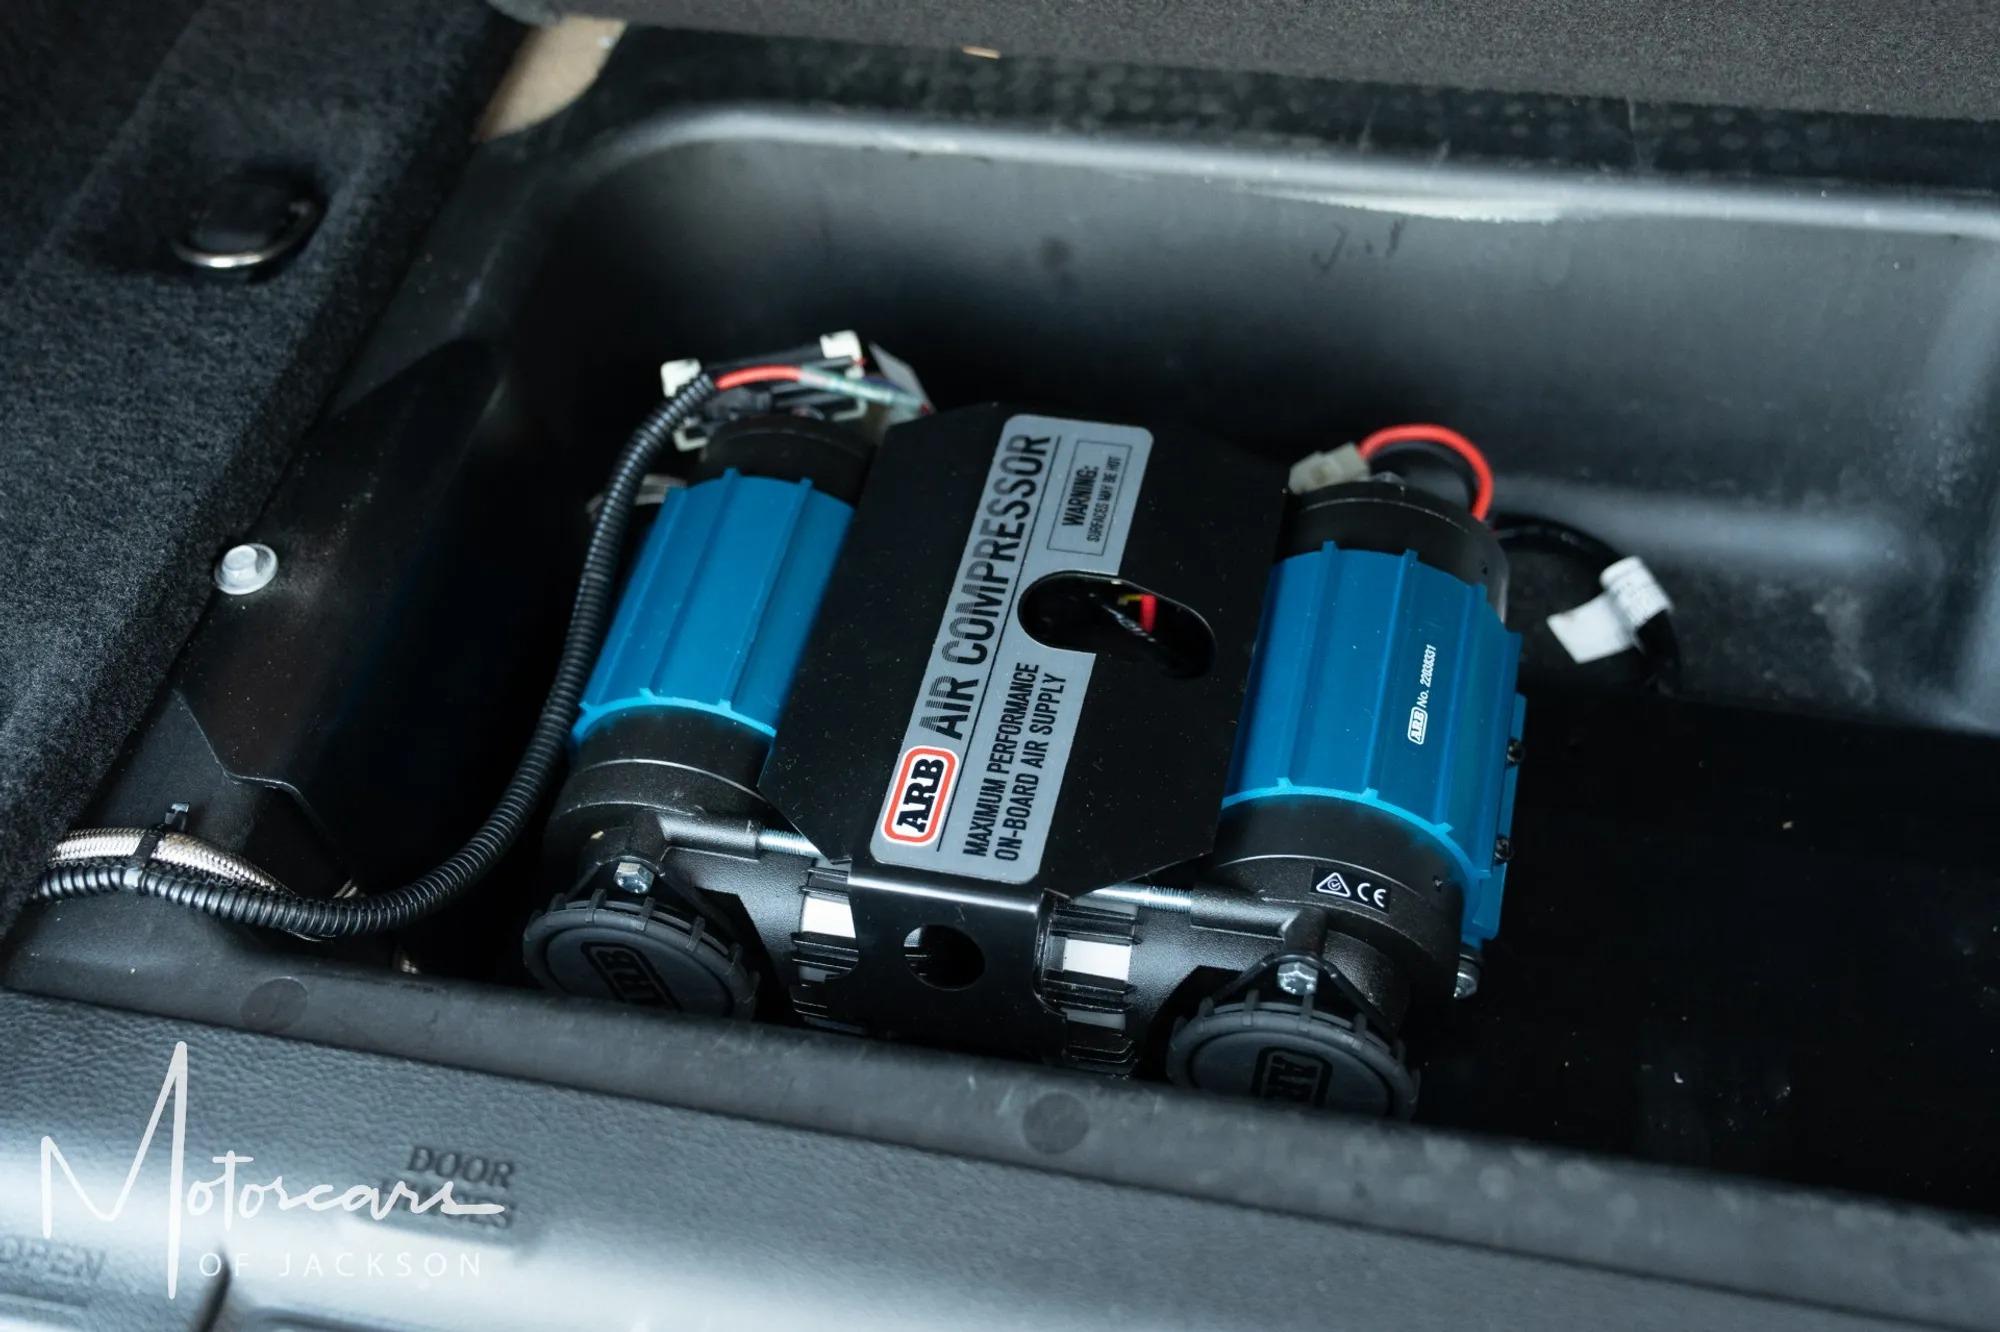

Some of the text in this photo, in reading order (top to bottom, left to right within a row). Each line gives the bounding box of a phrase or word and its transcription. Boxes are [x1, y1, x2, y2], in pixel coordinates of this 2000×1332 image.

[1061, 465, 1099, 526] WARNING:
[918, 434, 1051, 741] AIR COMPRESSOR
[1410, 710, 1425, 742] ARB
[1416, 690, 1429, 708] No.
[963, 662, 1040, 857] MAXIMUM PERFORMANCE
[994, 673, 1066, 861] ON-BOARD AIR SUPPLY
[896, 758, 945, 834] ARB
[406, 1147, 514, 1189] DOOR
